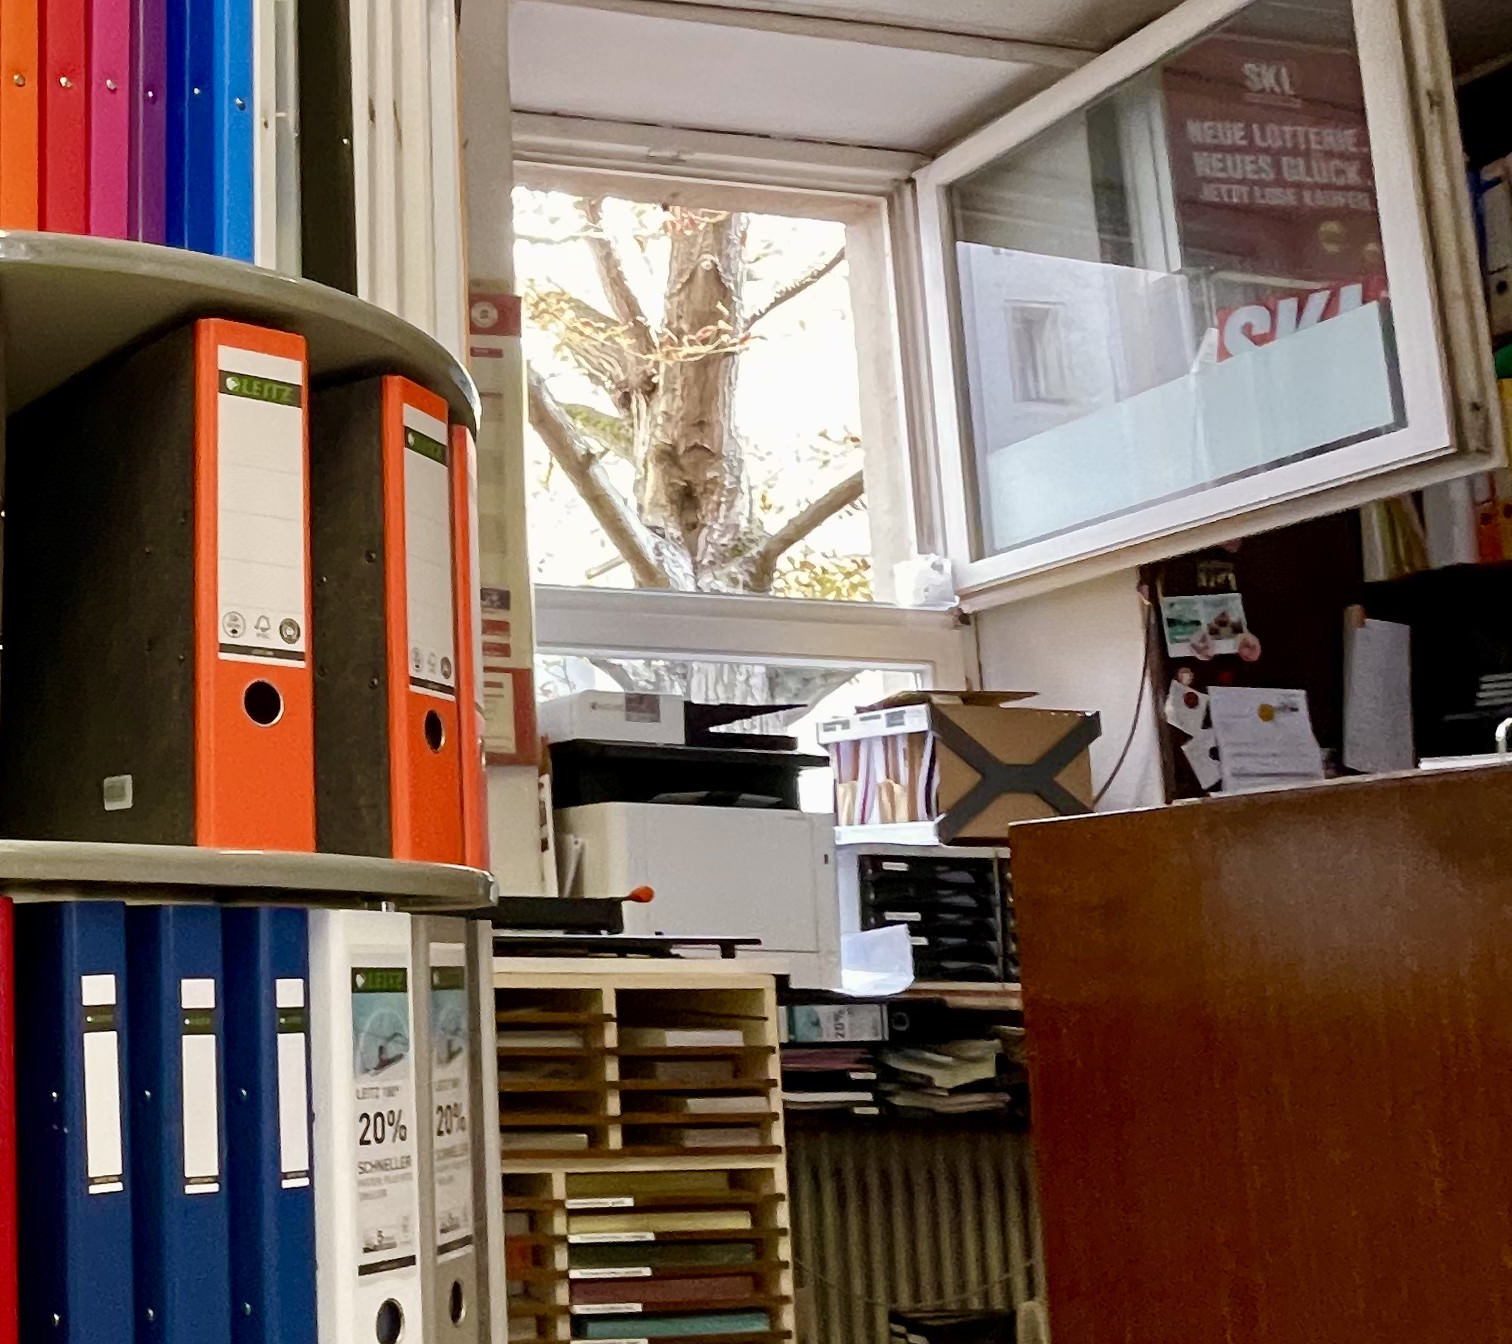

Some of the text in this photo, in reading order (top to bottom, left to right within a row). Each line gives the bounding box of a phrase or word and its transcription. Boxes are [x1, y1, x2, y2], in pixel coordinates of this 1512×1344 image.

[1241, 62, 1296, 95] SKL
[1187, 119, 1248, 146] NEUE
[1192, 150, 1275, 181] NEUES
[241, 379, 294, 403] LEITZ
[358, 1108, 408, 1146] 20%
[436, 1102, 467, 1137] 20%
[357, 1155, 412, 1175] SCHNELLER
